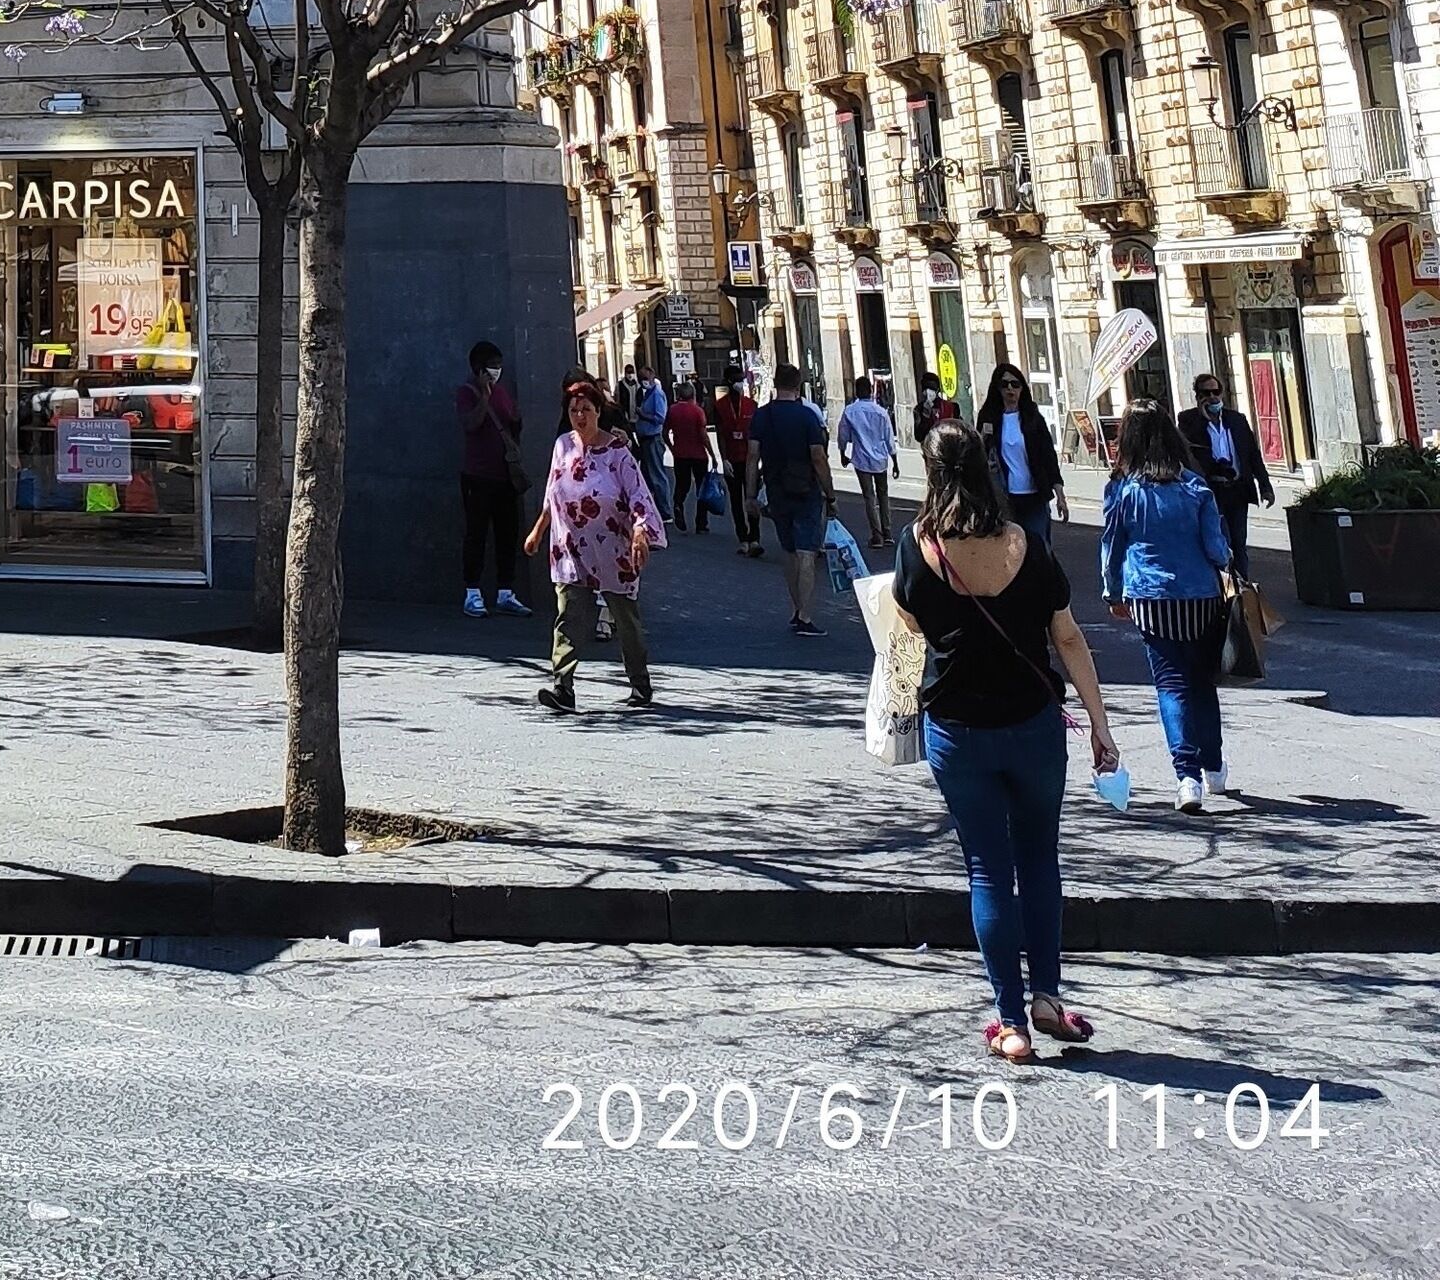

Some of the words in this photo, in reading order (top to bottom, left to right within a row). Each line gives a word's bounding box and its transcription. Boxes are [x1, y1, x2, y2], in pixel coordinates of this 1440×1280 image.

[99, 273, 142, 286] BORSA
[70, 422, 117, 430] PASHMINE
[85, 456, 122, 468] euro
